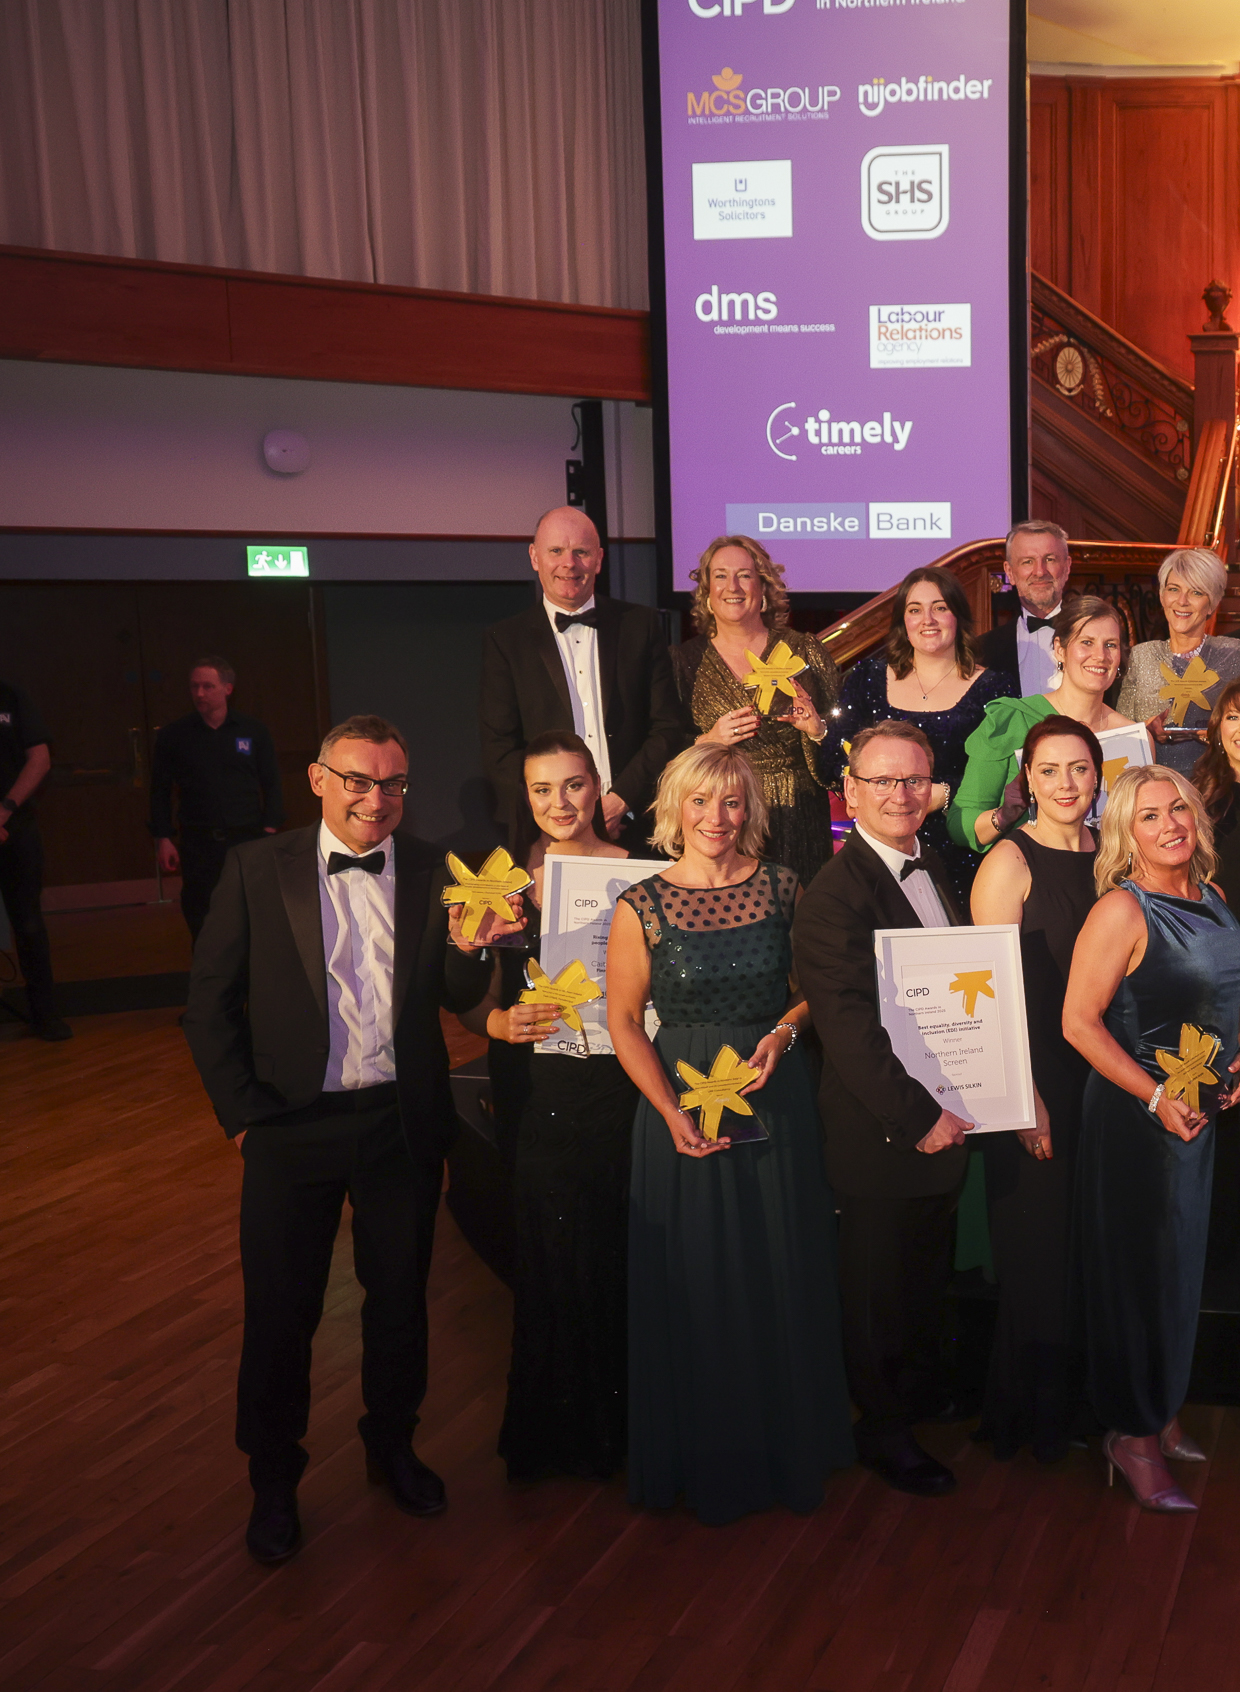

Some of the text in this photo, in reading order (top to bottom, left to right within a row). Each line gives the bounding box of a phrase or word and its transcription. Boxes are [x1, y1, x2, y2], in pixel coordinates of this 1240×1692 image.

[858, 74, 992, 117] nijobfinder
[688, 111, 829, 125] INTELLIGENT RECRUITMENT SOLUTIONS
[876, 179, 934, 205] SHS
[707, 196, 776, 211] Worthingtons
[718, 209, 766, 222] Solicitors
[885, 208, 925, 216] GROUP
[695, 285, 778, 323] dms
[877, 307, 945, 325] Labour
[714, 322, 835, 336] development means success
[877, 323, 963, 342] Relations
[876, 341, 923, 356] agency
[805, 408, 913, 451] timely
[821, 444, 862, 455] careers
[757, 511, 943, 533] Danske Bank
[574, 898, 599, 908] CIPD
[905, 987, 930, 998] CIPD
[557, 1039, 587, 1055] CIPD
[924, 1045, 984, 1060] Northern Ireland
[942, 1058, 968, 1067] Screen
[947, 1082, 982, 1092] LEWIS SILKIN
